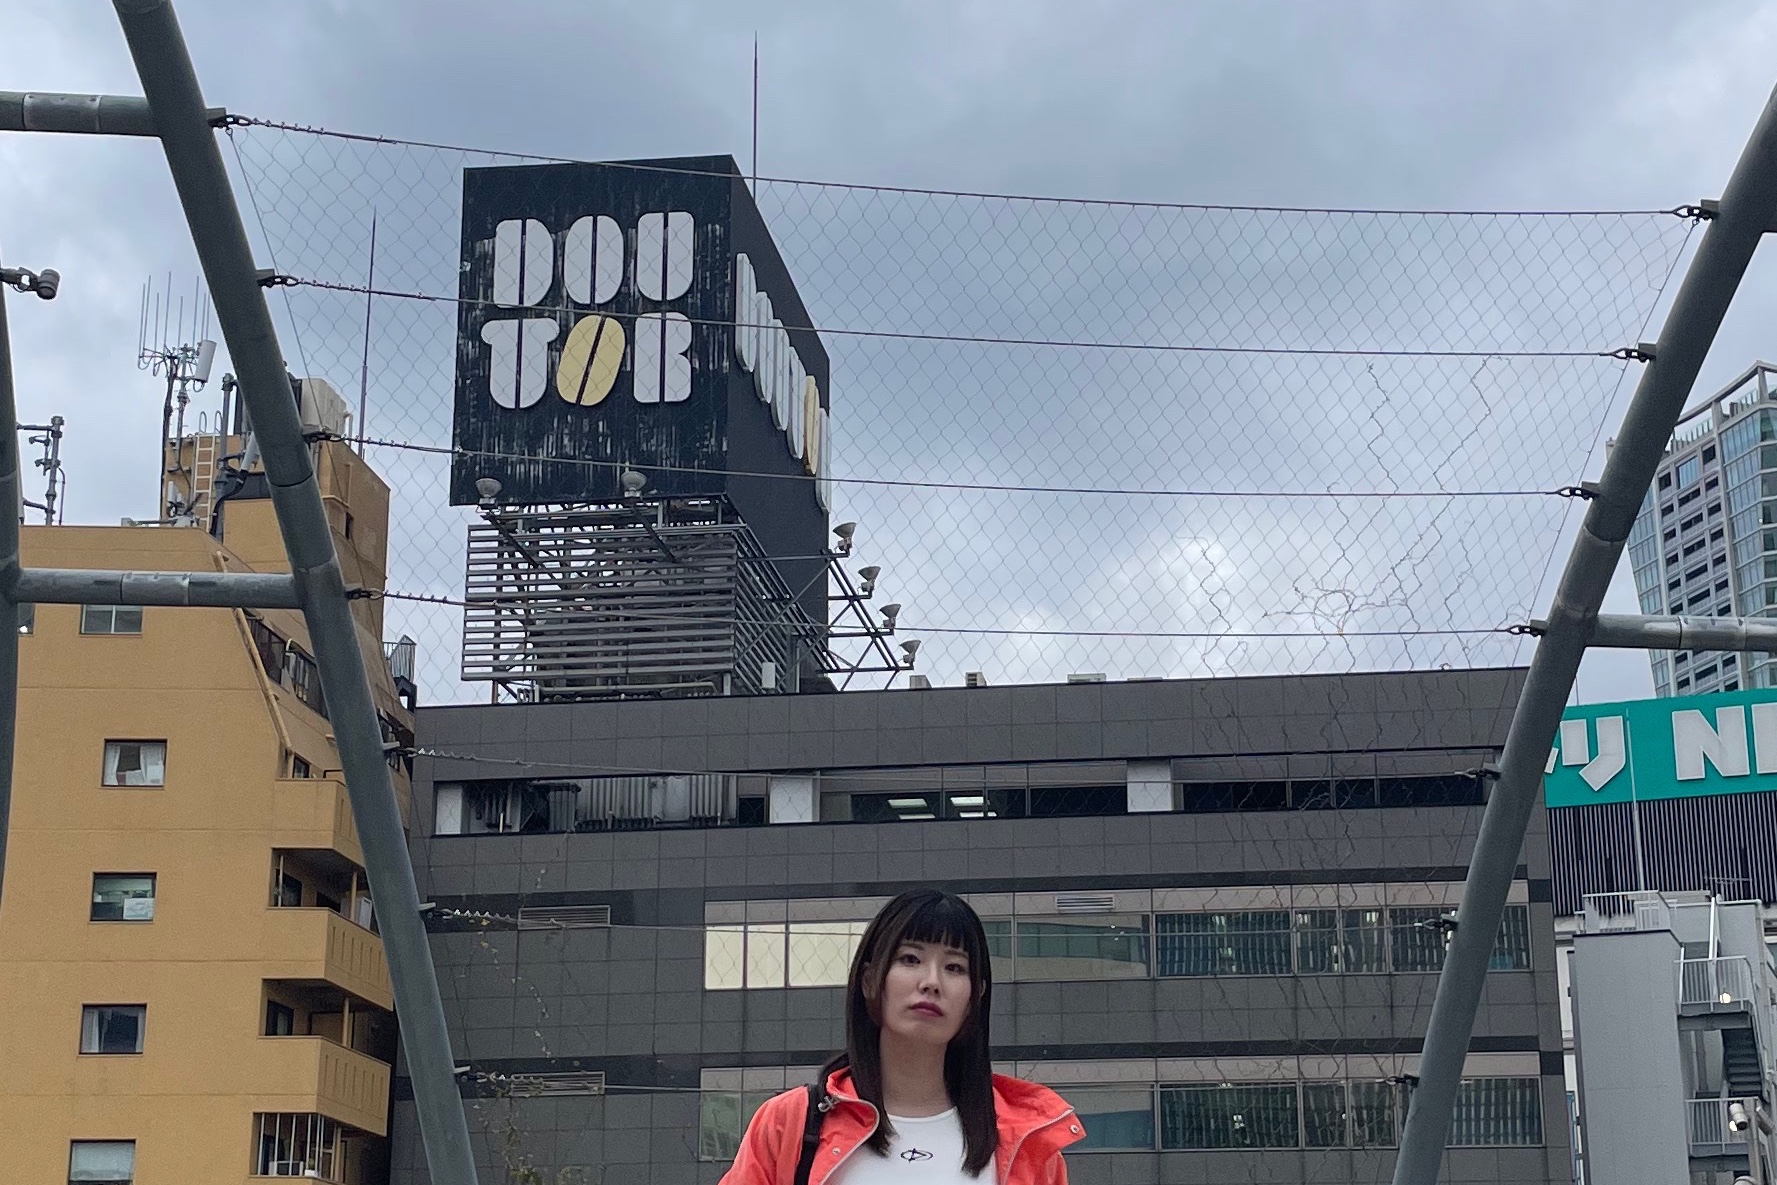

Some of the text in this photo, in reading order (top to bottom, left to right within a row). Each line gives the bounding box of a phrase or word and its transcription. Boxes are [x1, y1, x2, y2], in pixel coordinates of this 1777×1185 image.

[493, 211, 695, 308] DOU
[480, 312, 693, 409] TOR
[1544, 715, 1626, 792] リ
